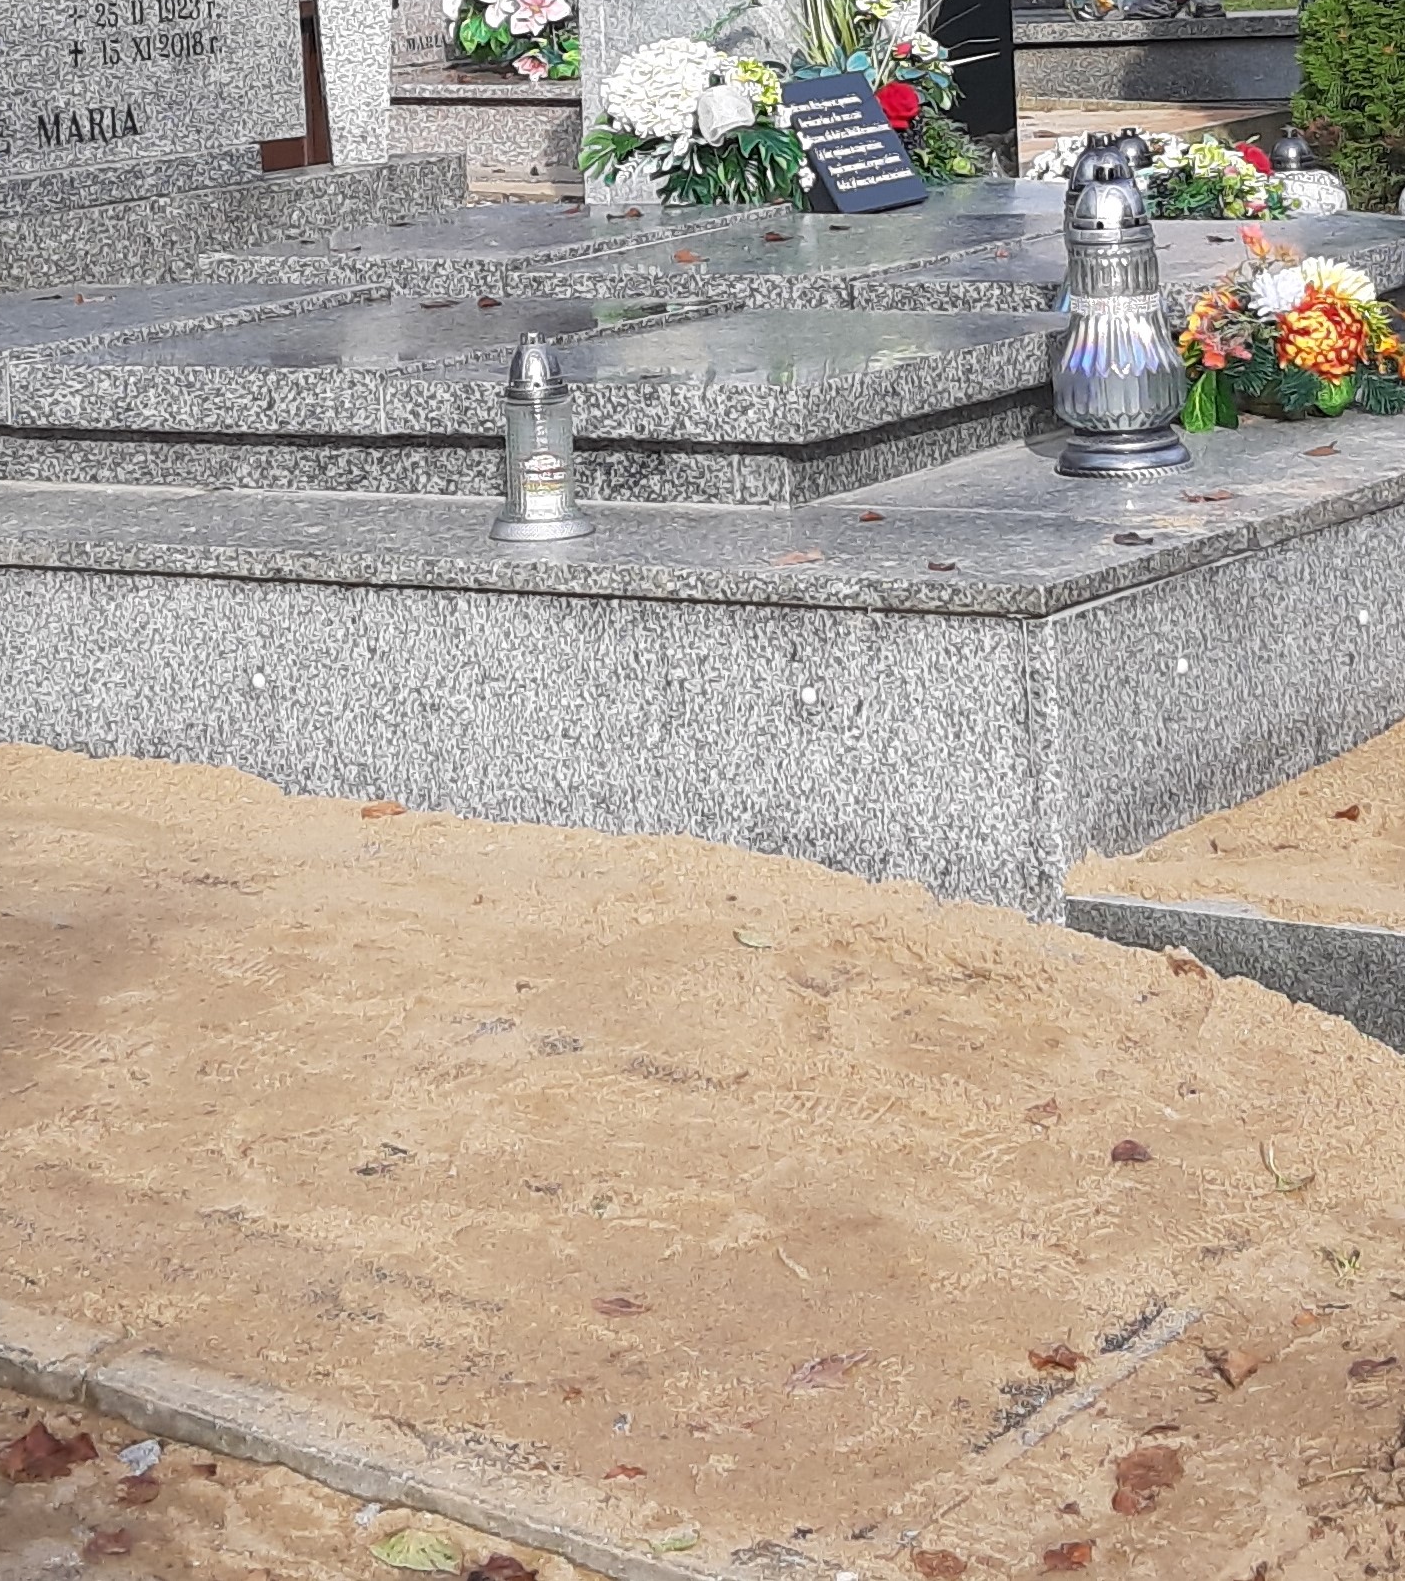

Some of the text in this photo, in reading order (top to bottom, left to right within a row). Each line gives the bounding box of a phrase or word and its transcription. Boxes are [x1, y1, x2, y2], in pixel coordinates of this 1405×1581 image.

[95, 2, 119, 28] 25
[102, 39, 121, 65] 15
[131, 35, 152, 62] XI
[158, 31, 204, 59] 2018
[38, 106, 141, 148] MARIA
